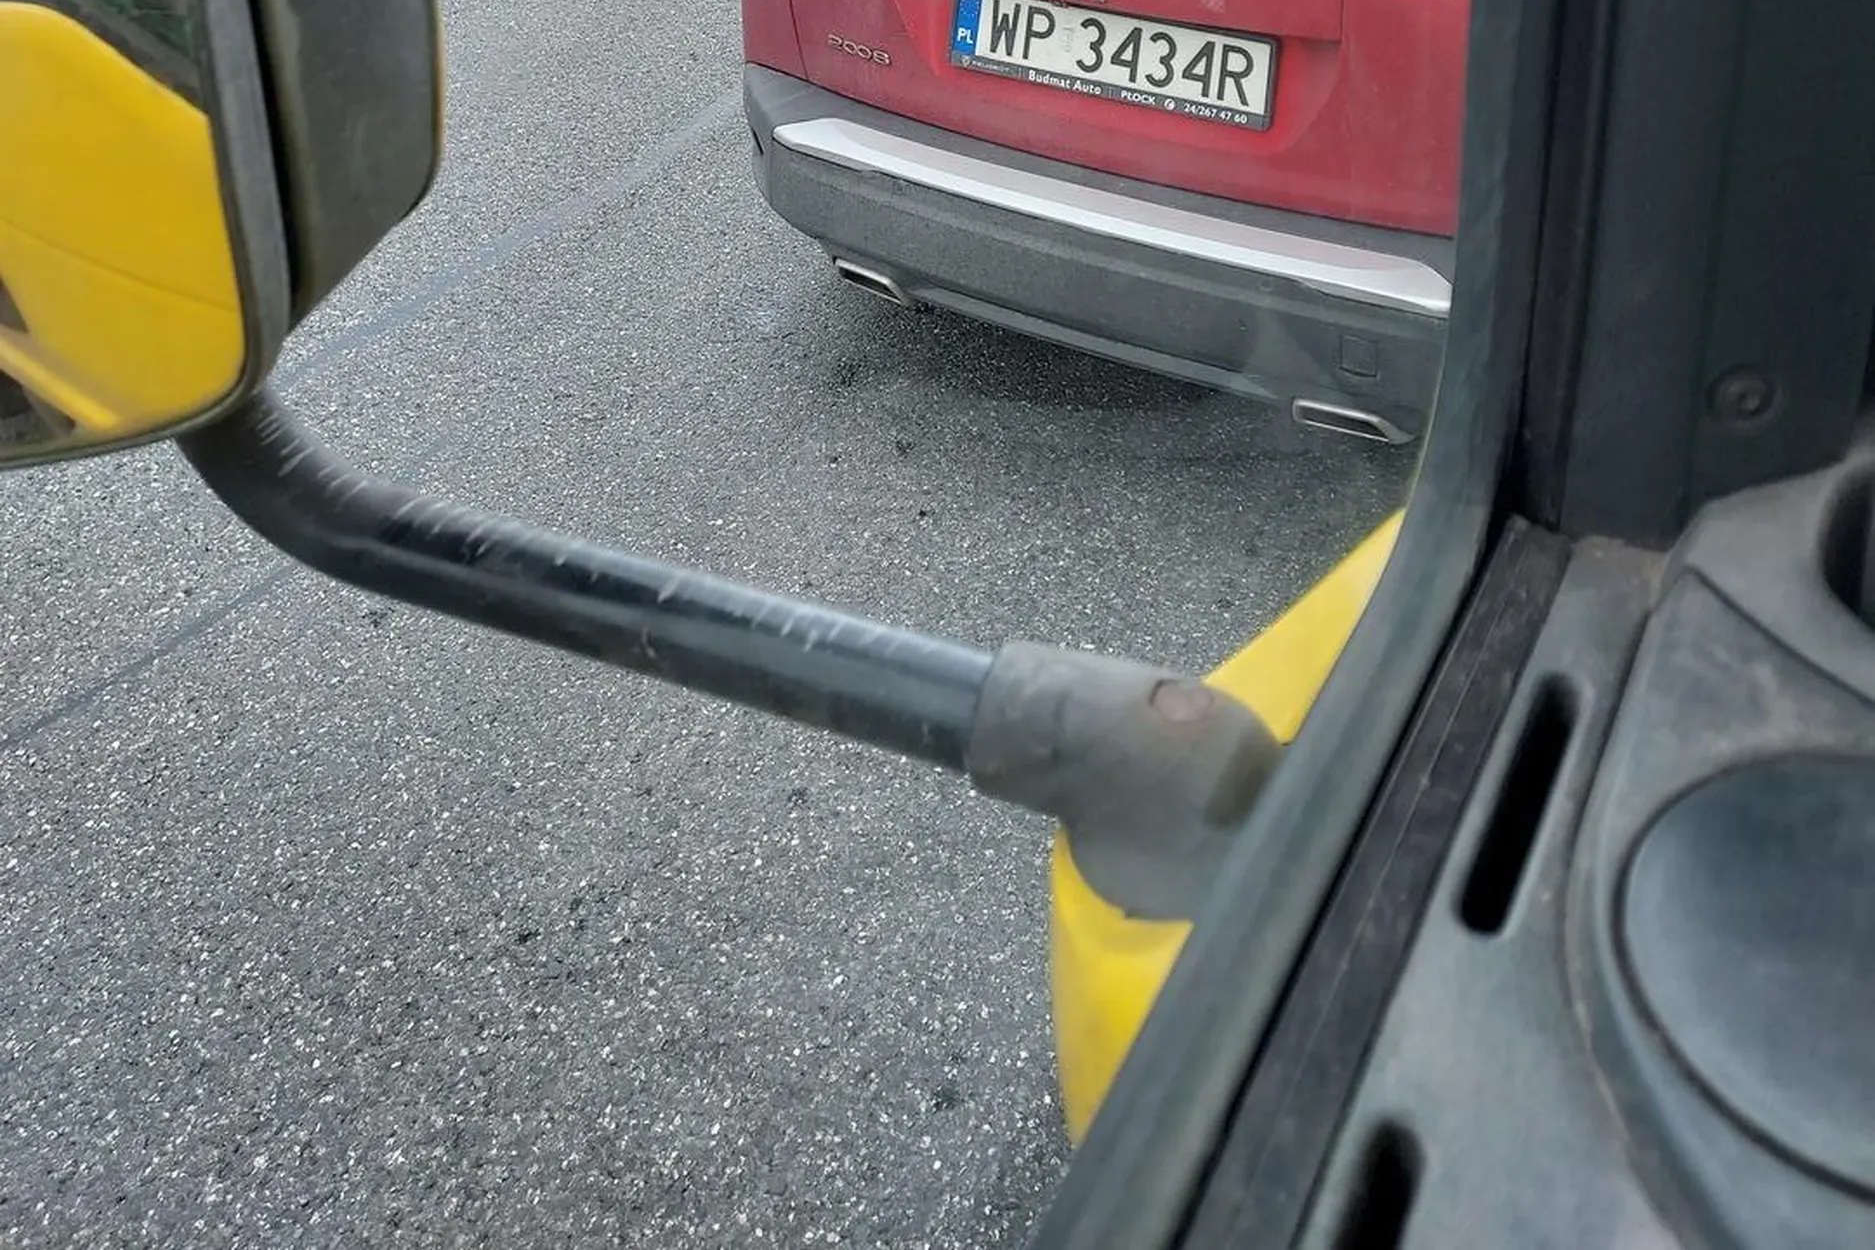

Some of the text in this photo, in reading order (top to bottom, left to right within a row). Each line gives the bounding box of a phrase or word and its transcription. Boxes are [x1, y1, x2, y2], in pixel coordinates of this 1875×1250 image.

[828, 33, 891, 65] 2008
[956, 28, 974, 44] PL
[988, 0, 1251, 107] WP 3434R
[1028, 69, 1102, 95] Budmat Auto
[1219, 109, 1232, 121] 47
[1233, 113, 1248, 125] 60
